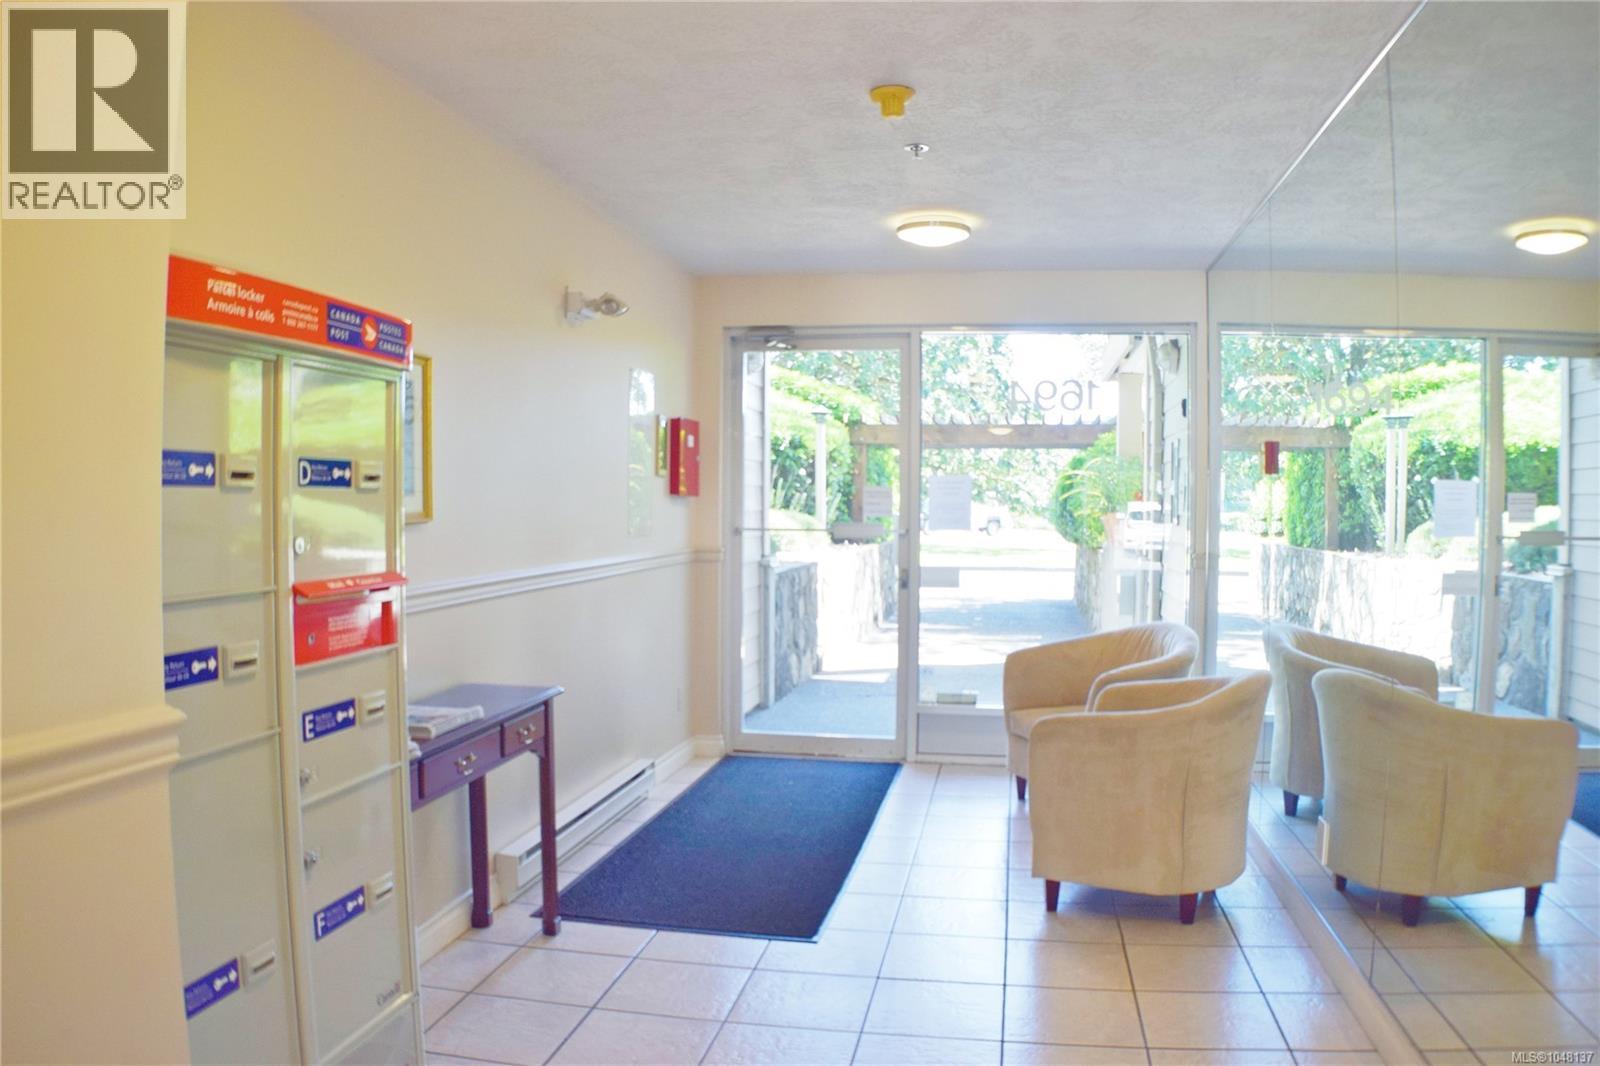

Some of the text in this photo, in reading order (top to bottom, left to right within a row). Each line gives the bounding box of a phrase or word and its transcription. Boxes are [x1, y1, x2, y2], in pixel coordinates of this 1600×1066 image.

[207, 278, 265, 304] Parcel locker
[206, 297, 246, 318] Armoire
[255, 308, 275, 324] colis
[330, 308, 361, 325] CANADA
[329, 327, 350, 342] POST
[379, 321, 402, 337] POSTES
[379, 340, 404, 354] CANADA
[299, 460, 311, 486] D
[305, 713, 314, 739] E
[316, 911, 326, 937] F
